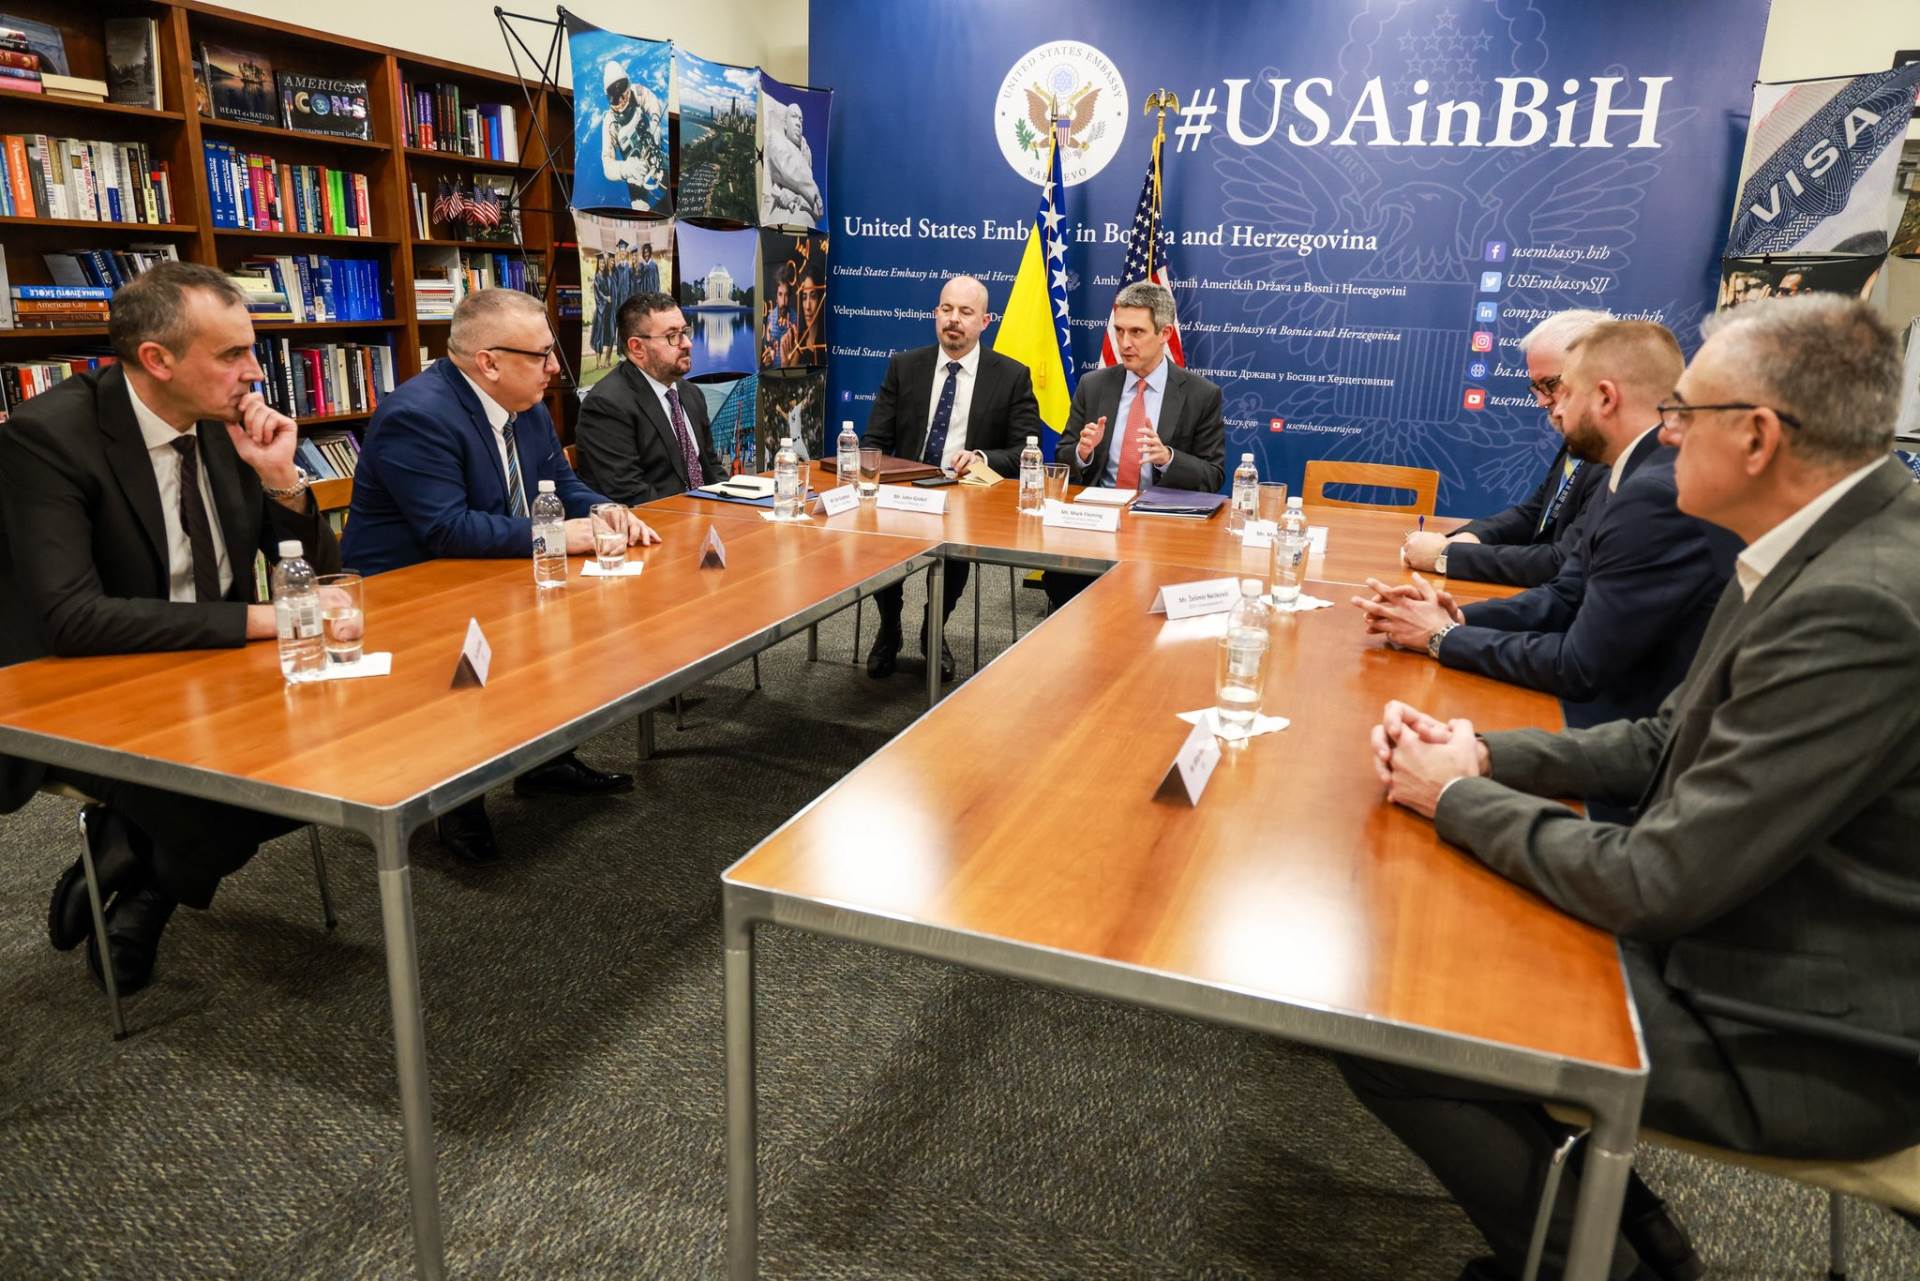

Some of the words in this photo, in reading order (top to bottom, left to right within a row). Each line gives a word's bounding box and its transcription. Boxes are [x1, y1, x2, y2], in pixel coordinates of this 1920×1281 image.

[1004, 57, 1036, 99] UNITED
[1039, 46, 1082, 59] STATES
[1085, 51, 1122, 98] EMBASSY
[284, 75, 363, 94] AMERICAN
[219, 105, 241, 116] HEART
[249, 111, 275, 121] NATION
[284, 90, 367, 119] ICONS
[1175, 75, 1673, 153] #USAinBiH
[1750, 106, 1882, 222] VISA
[844, 216, 912, 238] United
[918, 217, 976, 239] States
[1075, 222, 1097, 243] in
[1103, 222, 1176, 245] Boa
[1181, 223, 1224, 247] and
[1231, 225, 1378, 256] Herzegovina
[1512, 245, 1610, 263] usembassy.bih
[833, 265, 862, 276] United
[863, 266, 889, 277] States
[890, 267, 928, 281] Embassy
[929, 269, 939, 279] in
[1201, 277, 1254, 291] Američkih
[1256, 279, 1292, 293] Država
[1294, 284, 1301, 293] u
[1304, 282, 1333, 294] Bosni
[1342, 284, 1407, 297] Hercegovini
[833, 305, 892, 318] Veleposlanstvo
[893, 307, 937, 321] Sjedinjeni
[1193, 321, 1221, 332] States
[1223, 322, 1264, 337] Embassy
[1266, 325, 1276, 335] in
[1278, 325, 1312, 337] Bosnia
[1314, 326, 1335, 338] and
[1337, 328, 1401, 343] Herzegovina
[832, 345, 860, 356] United
[861, 347, 887, 358] States
[1239, 369, 1276, 381] Држава
[1286, 371, 1316, 383] Босни
[1318, 374, 1325, 383] и
[1327, 374, 1394, 387] Херцеговини
[1286, 421, 1362, 436] usembassysarajevo
